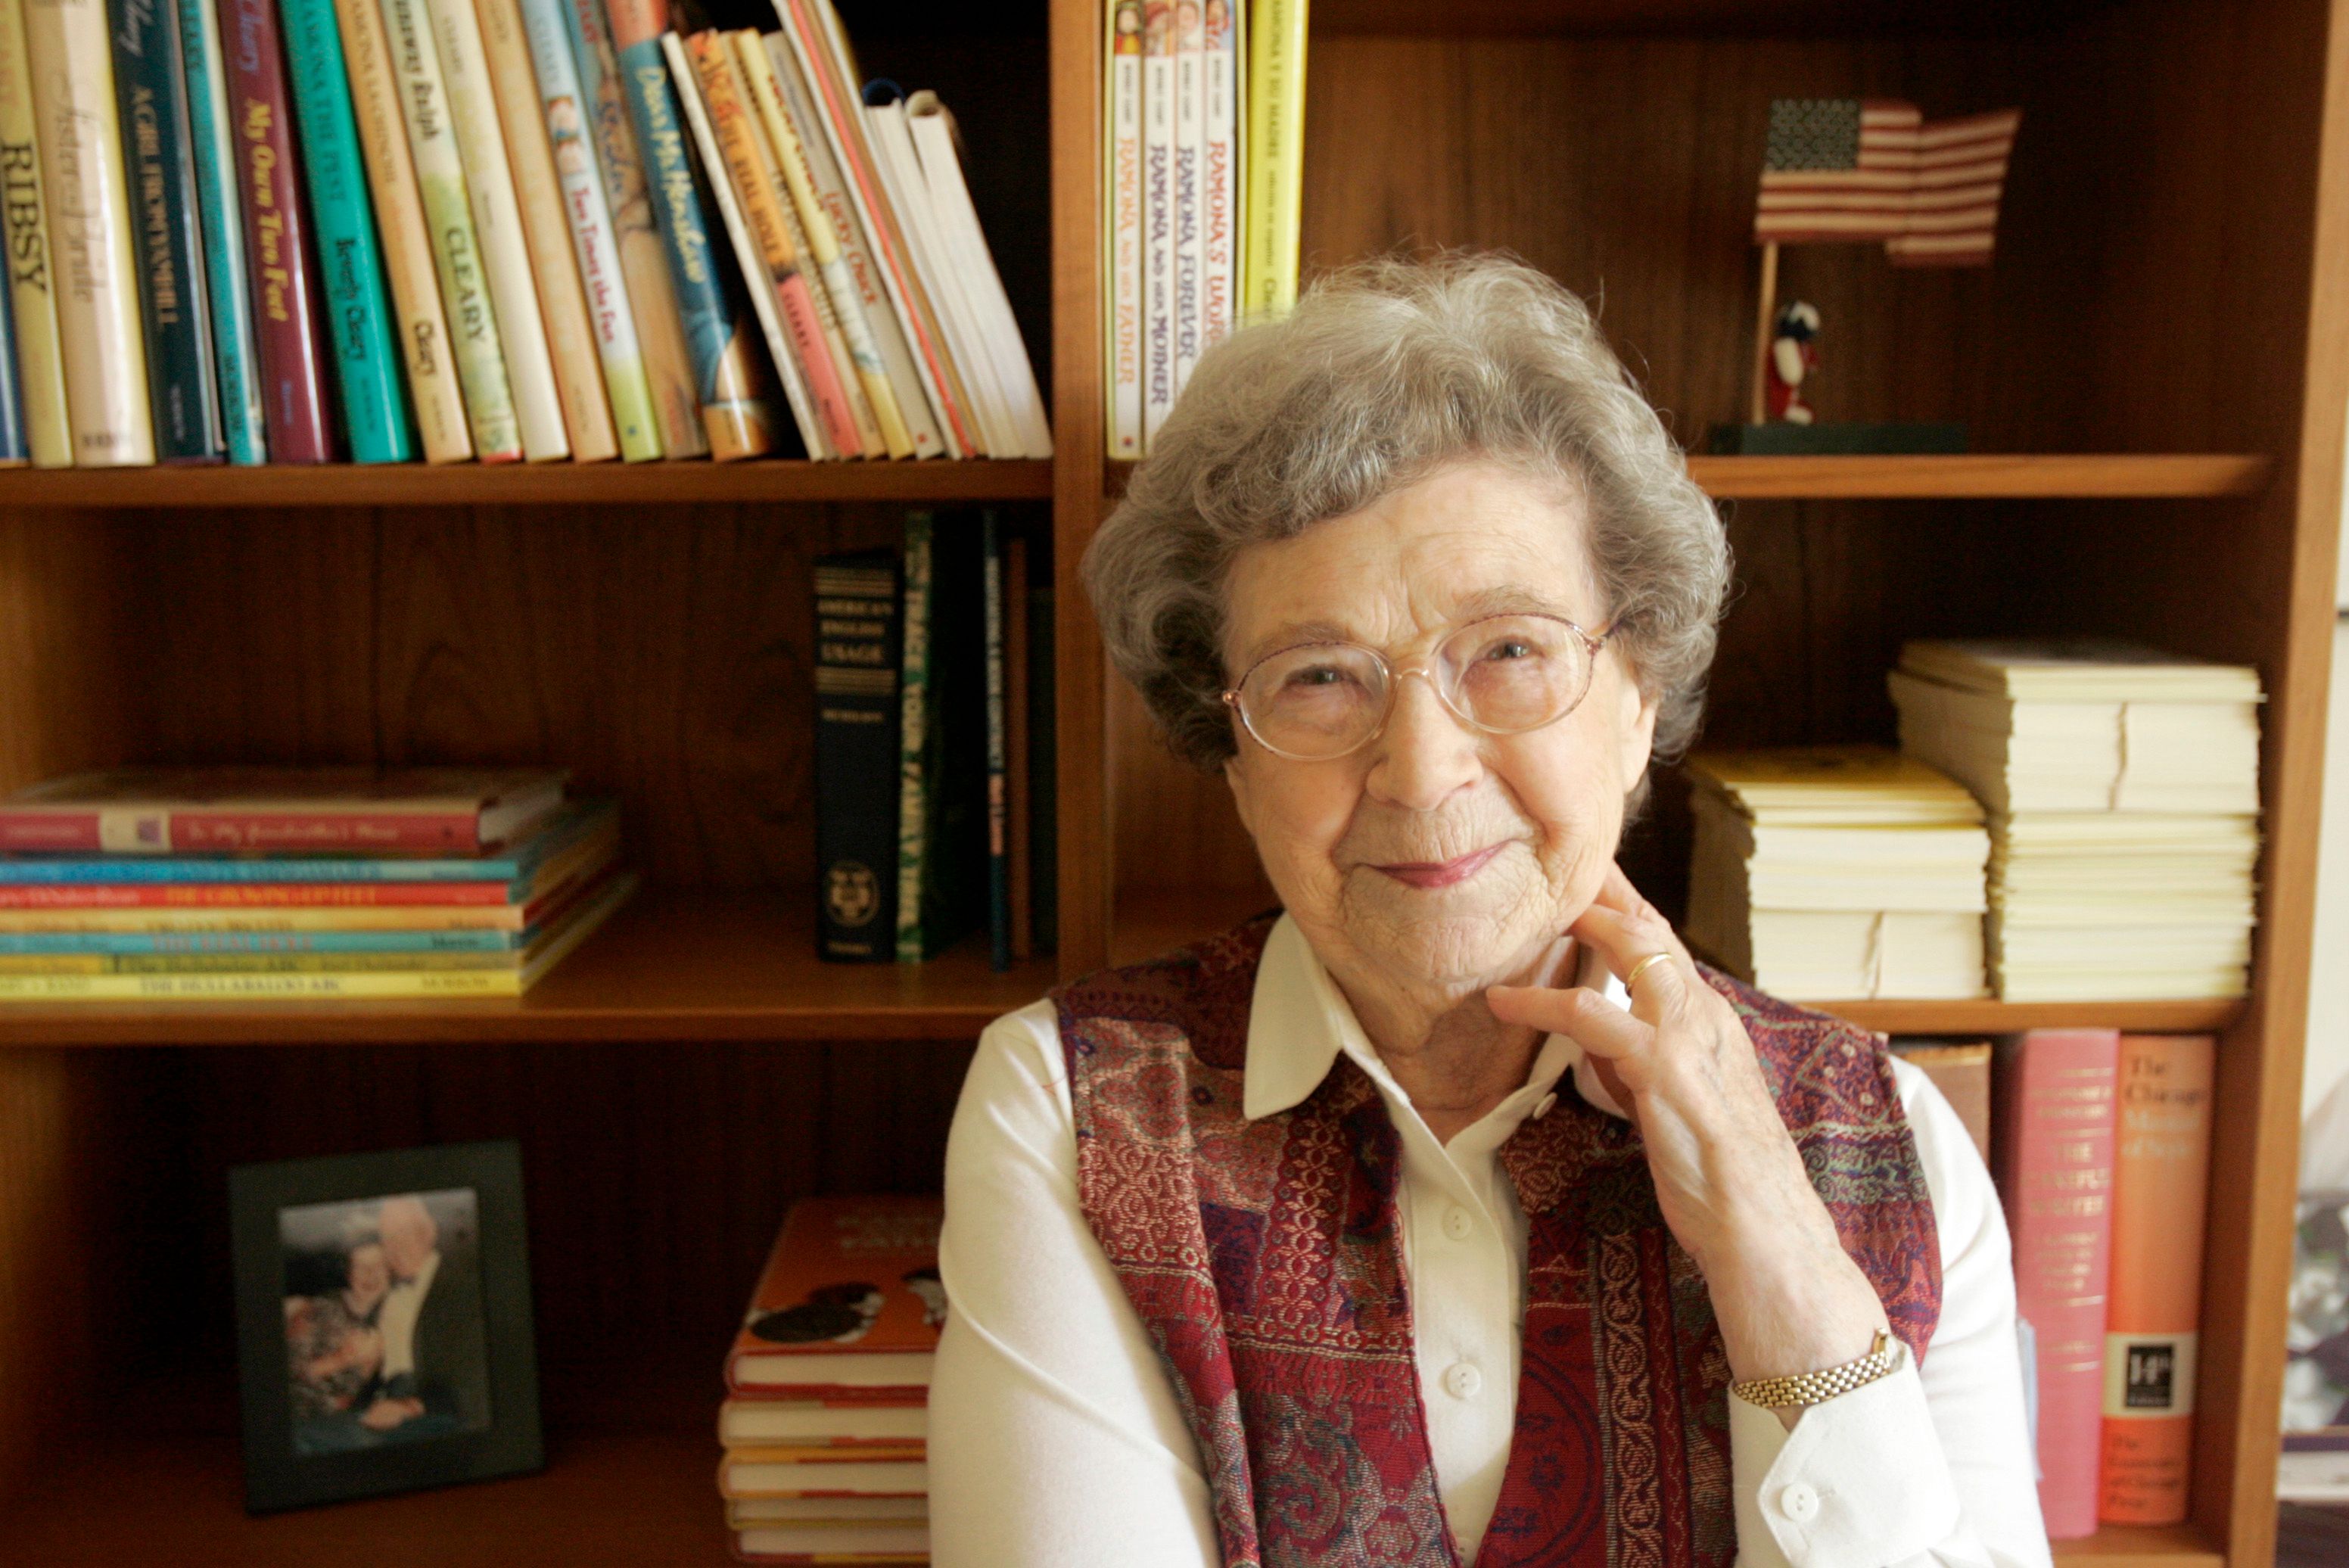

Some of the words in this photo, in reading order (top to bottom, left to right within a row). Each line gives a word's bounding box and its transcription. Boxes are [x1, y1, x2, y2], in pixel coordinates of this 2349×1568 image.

[348, 0, 379, 73] AMONA
[390, 0, 426, 73] unaway
[239, 97, 274, 140] My
[406, 82, 446, 140] Ralph
[633, 66, 678, 127] Dear
[247, 142, 282, 207] Own
[569, 186, 596, 220] Two
[1117, 137, 1137, 232] RAMONA
[1150, 144, 1168, 242] RAMONA
[1174, 145, 1197, 245] RAMONA
[1206, 139, 1226, 265] RAMONA'S
[1, 142, 48, 291] RIBSY
[254, 208, 287, 264] Two
[655, 170, 715, 282] Henshaw
[813, 191, 860, 244] Lucky
[843, 251, 882, 304] Chuck
[576, 222, 608, 275] Times
[1153, 248, 1165, 275] AND
[261, 266, 293, 321] Feet
[441, 226, 488, 340] CLEARY
[590, 278, 614, 306] the
[1174, 254, 1197, 359] FOREVER
[1206, 275, 1226, 337] WOR
[334, 304, 373, 360] Cleary
[403, 320, 443, 375] Cleary
[597, 310, 623, 343] Fun
[780, 294, 814, 348] CLEARY
[1116, 304, 1135, 384] FATHER
[1150, 316, 1168, 403] MOTHER
[2131, 1057, 2166, 1077] The
